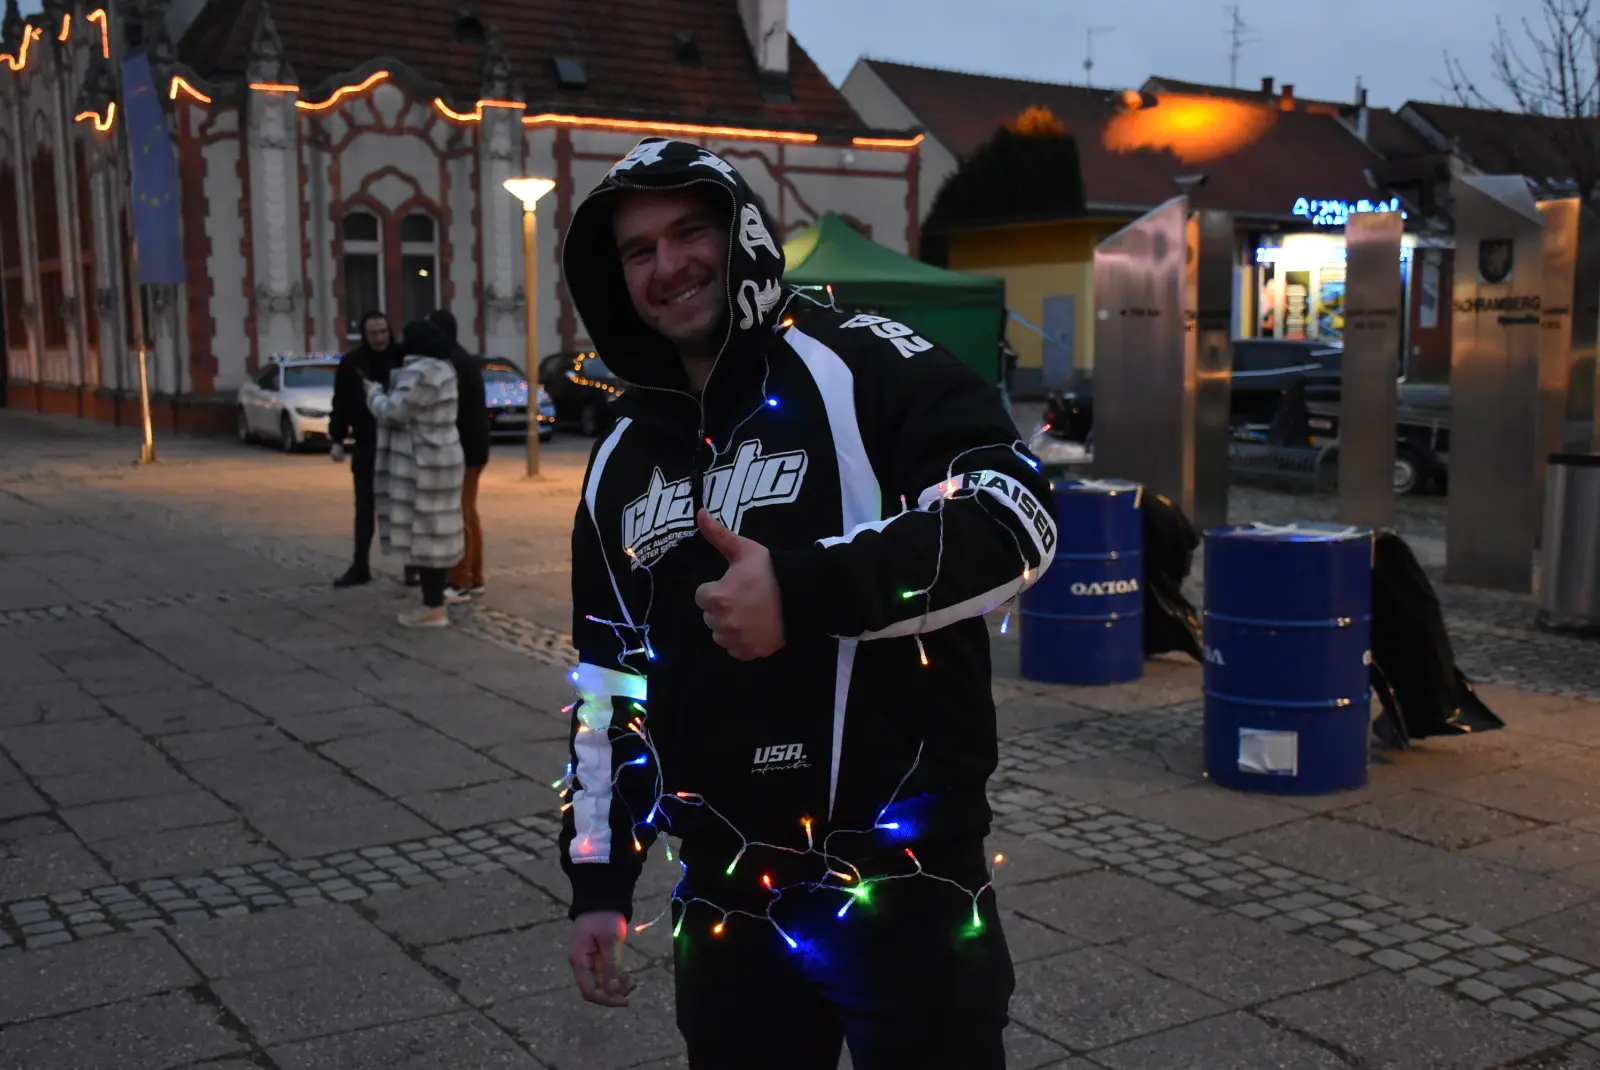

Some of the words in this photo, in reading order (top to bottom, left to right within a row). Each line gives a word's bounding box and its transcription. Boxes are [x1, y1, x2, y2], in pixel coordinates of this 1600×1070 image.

[962, 472, 1055, 555] RAISED
[1070, 578, 1140, 597] VOLVO
[753, 743, 807, 765] USA.
